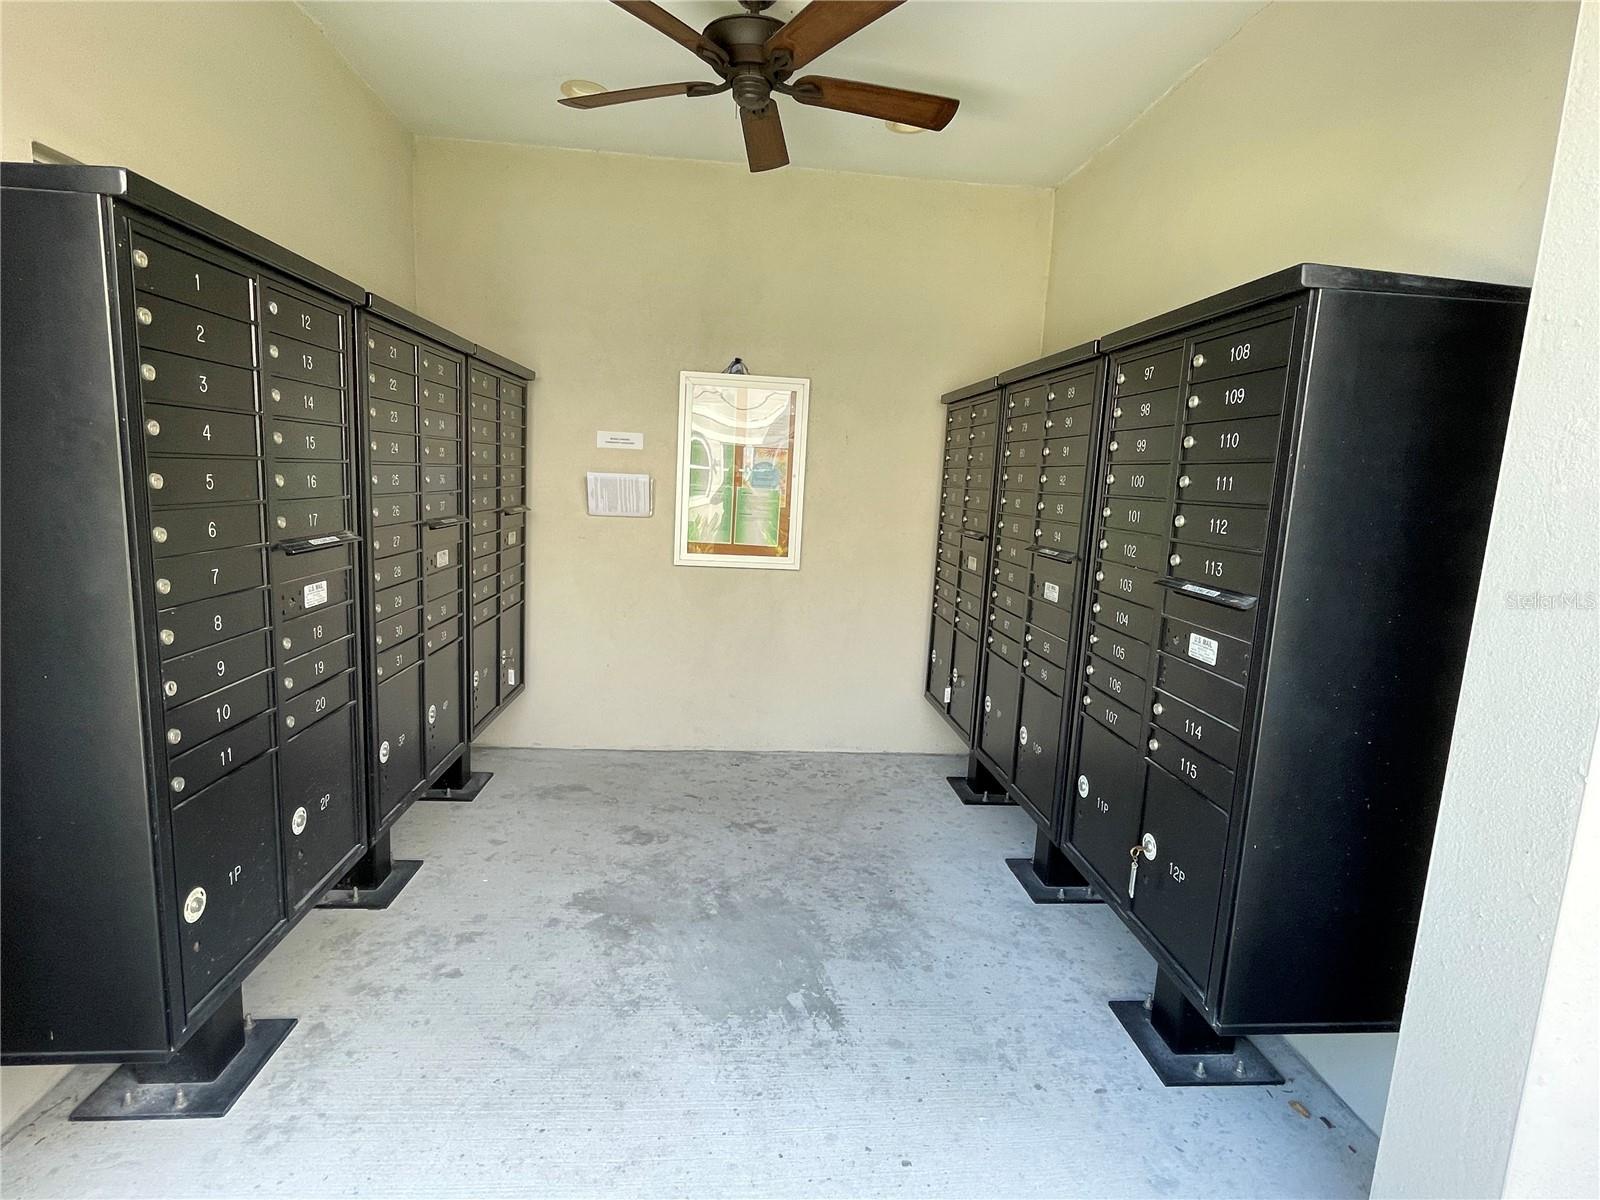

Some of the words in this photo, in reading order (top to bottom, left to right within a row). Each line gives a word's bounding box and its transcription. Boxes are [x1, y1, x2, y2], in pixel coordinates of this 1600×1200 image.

[195, 274, 199, 290] 1
[302, 314, 311, 329] 12
[197, 325, 205, 342] 2
[390, 346, 396, 358] 21
[1231, 344, 1250, 361] 108
[303, 355, 312, 369] 13
[1145, 367, 1154, 380] 97
[200, 376, 207, 392] 3
[390, 379, 397, 391] 22
[1068, 387, 1075, 398] 89
[1226, 388, 1244, 404] 109
[304, 396, 313, 409] 14
[1141, 403, 1150, 416] 98
[391, 411, 398, 422] 23
[1065, 417, 1072, 427] 90
[203, 425, 211, 440] 4
[306, 436, 315, 449] 15
[1137, 440, 1146, 452] 99
[1221, 433, 1239, 448] 110
[391, 443, 398, 453] 24
[1063, 447, 1069, 456] 91
[206, 474, 213, 489] 5
[307, 475, 316, 487] 16
[392, 475, 399, 485] 25
[1060, 475, 1066, 485] 92
[1132, 475, 1144, 487] 100
[1217, 477, 1232, 490] 111
[392, 506, 399, 516] 26
[1057, 504, 1063, 514] 93
[309, 514, 317, 526] 17
[1129, 510, 1140, 522] 101
[209, 522, 216, 537] 6
[1211, 519, 1227, 534] 112
[393, 536, 400, 547] 27
[1054, 532, 1060, 542] 94
[1124, 544, 1136, 557] 102
[394, 566, 401, 577] 28
[1206, 560, 1222, 576] 113
[211, 569, 218, 584] 7
[1120, 579, 1132, 592] 103
[395, 596, 402, 607] 29
[215, 615, 222, 630] 8
[1117, 612, 1128, 626] 104
[313, 625, 322, 639] 18
[396, 625, 402, 637] 30
[1043, 642, 1049, 653] 95
[1202, 638, 1213, 648] MAIL
[1113, 645, 1124, 659] 105
[396, 654, 402, 666] 31
[217, 661, 224, 676] 9
[315, 661, 323, 675] 19
[1041, 669, 1047, 680] 96
[1110, 677, 1121, 693] 106
[316, 697, 325, 712] 20
[217, 704, 230, 722] 10
[1106, 709, 1117, 724] 107
[1186, 720, 1201, 739] 114
[221, 748, 231, 765] 11
[1181, 758, 1196, 778] 115
[321, 794, 330, 810] 2P
[1098, 798, 1108, 813] 11P
[229, 866, 241, 885] 1P
[1170, 863, 1185, 883] 12P
